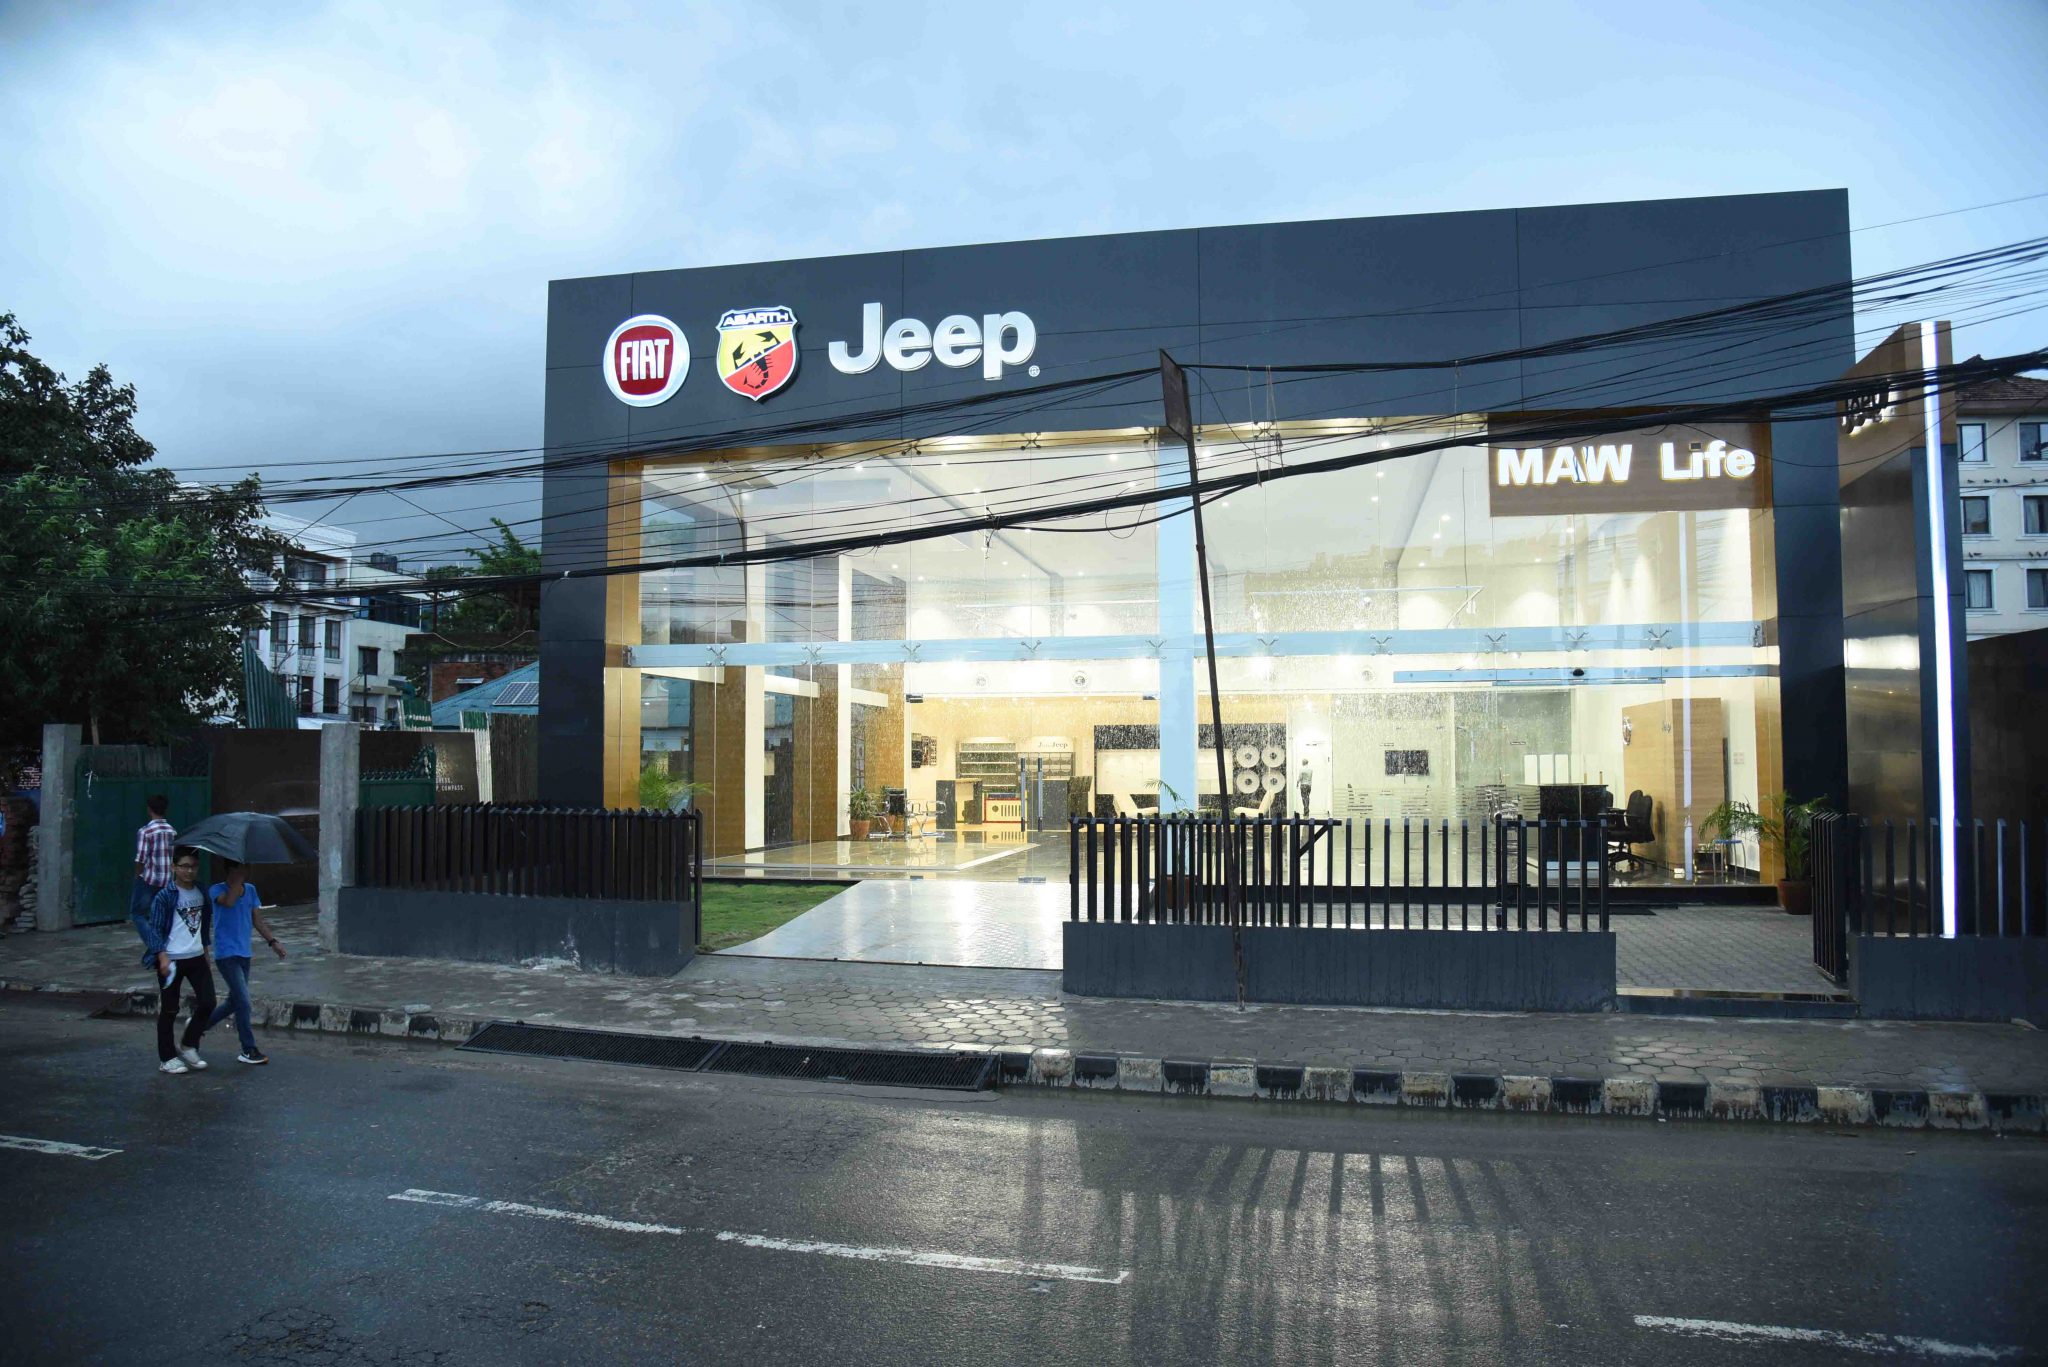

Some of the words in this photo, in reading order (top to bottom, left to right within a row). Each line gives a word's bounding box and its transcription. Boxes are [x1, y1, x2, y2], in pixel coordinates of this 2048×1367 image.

[723, 311, 788, 327] ABARTH
[621, 338, 669, 381] FIAT
[828, 302, 1036, 381] Jeep
[1497, 444, 1632, 485] MAW
[1660, 440, 1756, 480] Life
